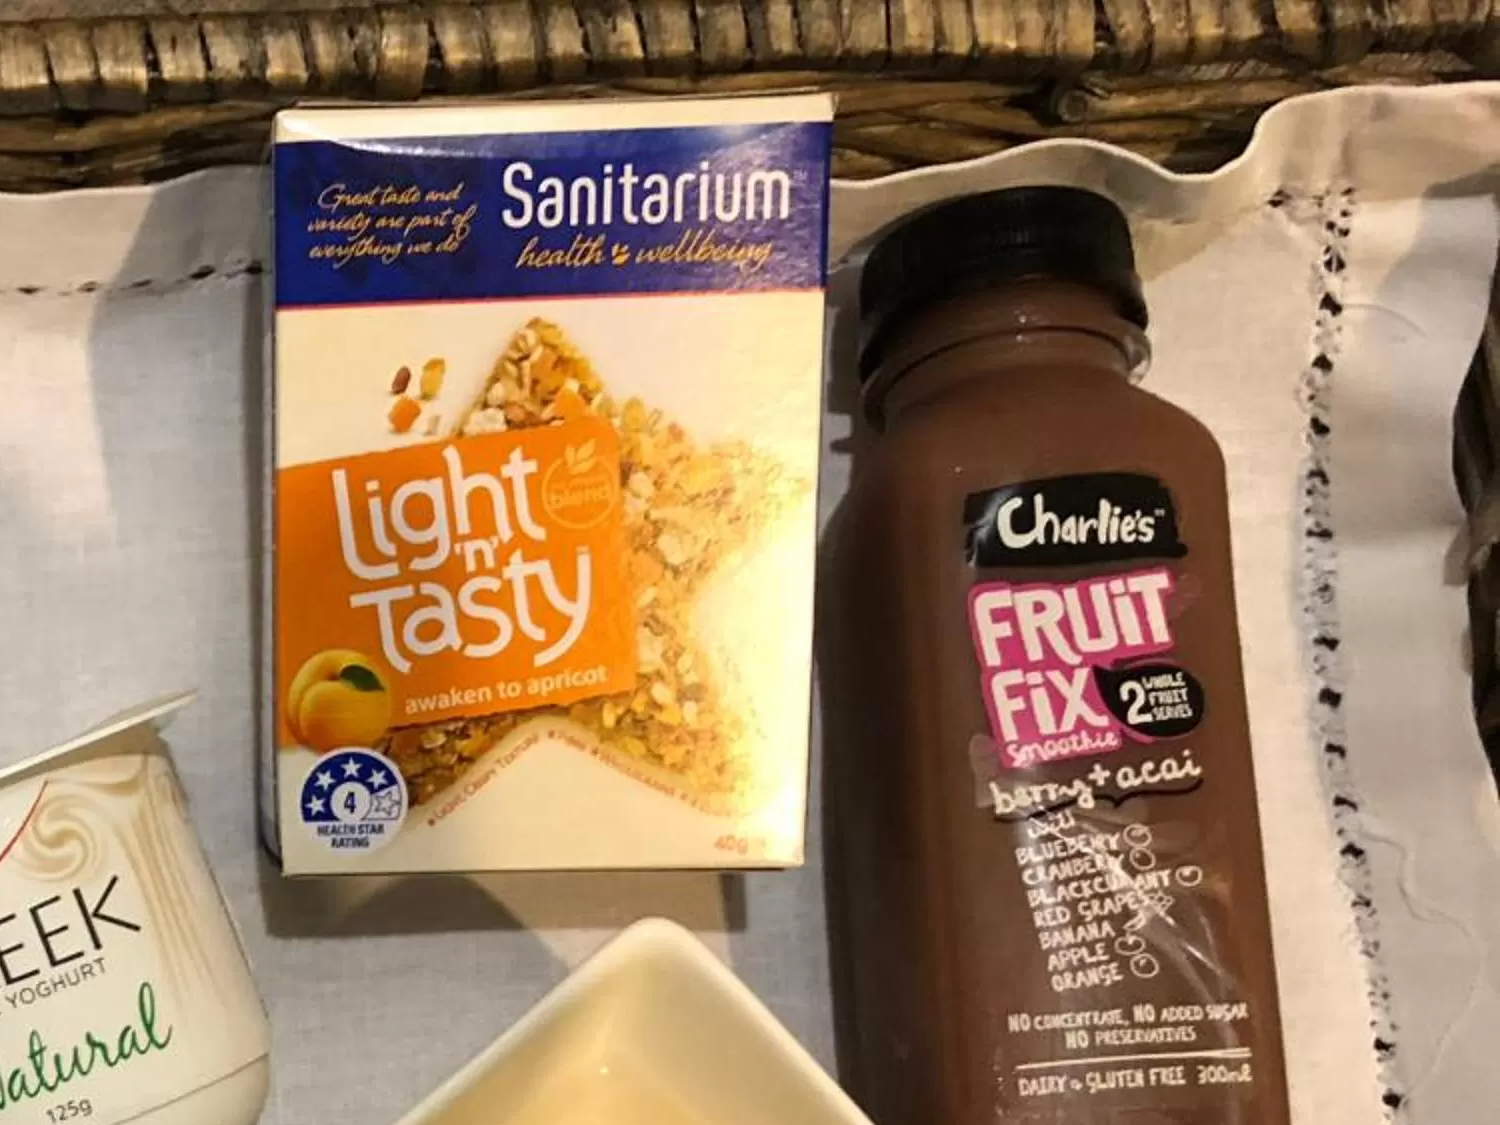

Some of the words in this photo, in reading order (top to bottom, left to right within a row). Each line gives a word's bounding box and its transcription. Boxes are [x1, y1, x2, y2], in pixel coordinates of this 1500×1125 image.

[317, 183, 382, 214] Great
[381, 184, 421, 205] taste
[425, 181, 465, 201] and
[502, 161, 790, 228] Sanitarium
[308, 211, 371, 241] variety
[375, 214, 406, 229] are
[403, 207, 453, 237] part
[451, 202, 479, 241] of
[309, 236, 403, 269] everything
[407, 242, 433, 254] we
[436, 233, 460, 253] do
[516, 233, 606, 269] health
[635, 228, 773, 272] wellbeing
[332, 445, 547, 580] Light
[997, 493, 1156, 549] Charlie's
[349, 547, 592, 674] Tasty
[406, 685, 492, 715] awaken
[496, 680, 522, 699] to
[527, 665, 609, 697] apricot
[1141, 671, 1187, 690] WHOLE
[1119, 680, 1153, 725] 2
[1148, 687, 1188, 706] FRUIT
[1152, 703, 1193, 721] SERVES
[990, 778, 1095, 815] berry
[1116, 749, 1202, 789] acai
[344, 791, 357, 815] 4
[317, 824, 357, 836] HEALTH
[357, 823, 385, 834] STAR
[331, 837, 369, 848] RATING
[1033, 905, 1071, 929] RED
[1038, 920, 1116, 950] BANANA
[1048, 942, 1110, 973] APPLE
[5, 956, 108, 1009] YOGHURT
[1050, 962, 1125, 993] ORANGE
[1008, 1013, 1032, 1033] NO
[1132, 1003, 1155, 1023] NO
[1160, 1006, 1204, 1023] ADDED
[1205, 1002, 1250, 1024] SUGAR
[1065, 1031, 1089, 1049] NO
[1095, 1025, 1198, 1046] PRESERVATIVES
[1018, 1074, 1068, 1097] DAIRY
[1085, 1069, 1145, 1095] GLUTEN
[1149, 1065, 1187, 1087] FREE
[45, 1098, 93, 1125] 125g
